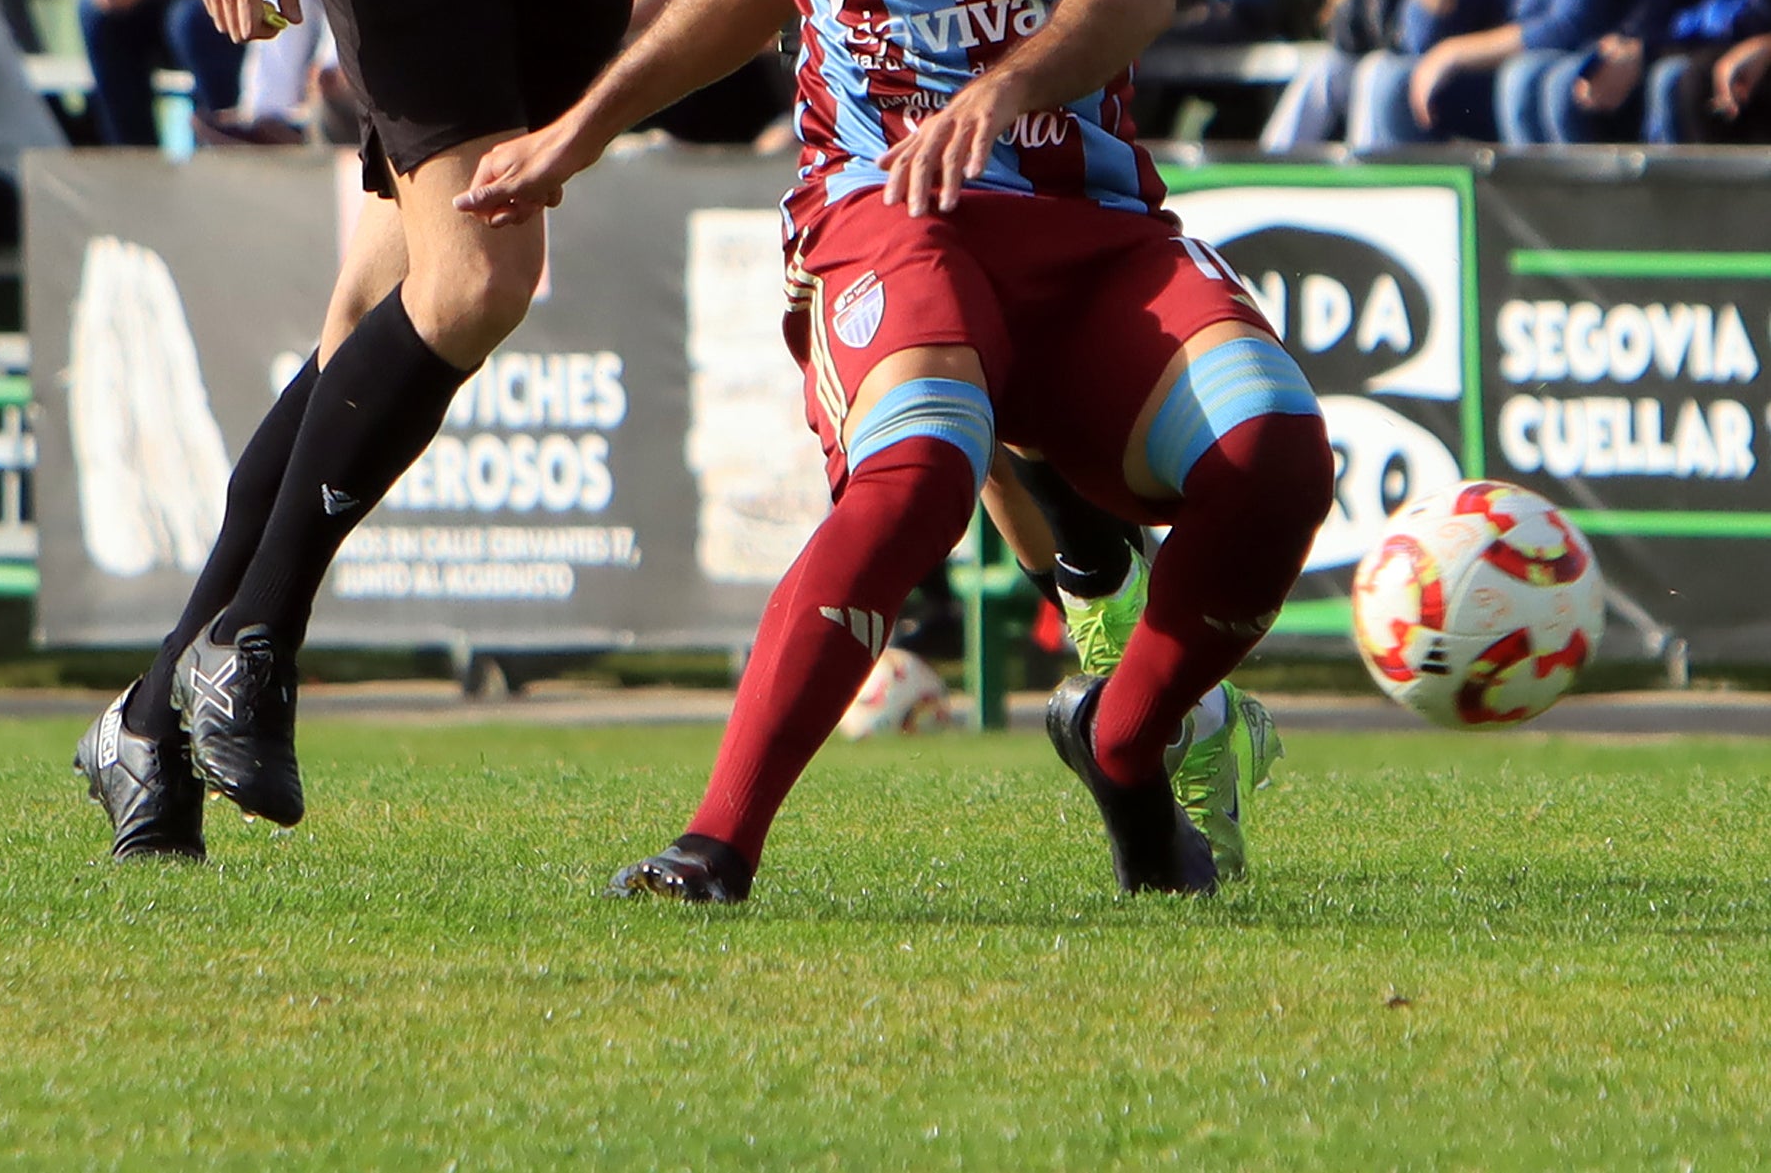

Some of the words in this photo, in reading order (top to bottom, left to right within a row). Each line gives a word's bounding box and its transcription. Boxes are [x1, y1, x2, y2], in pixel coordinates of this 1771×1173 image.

[1238, 269, 1414, 355] NDA
[1496, 298, 1761, 384] SEGOVIA
[1497, 393, 1759, 480] CUELLAR
